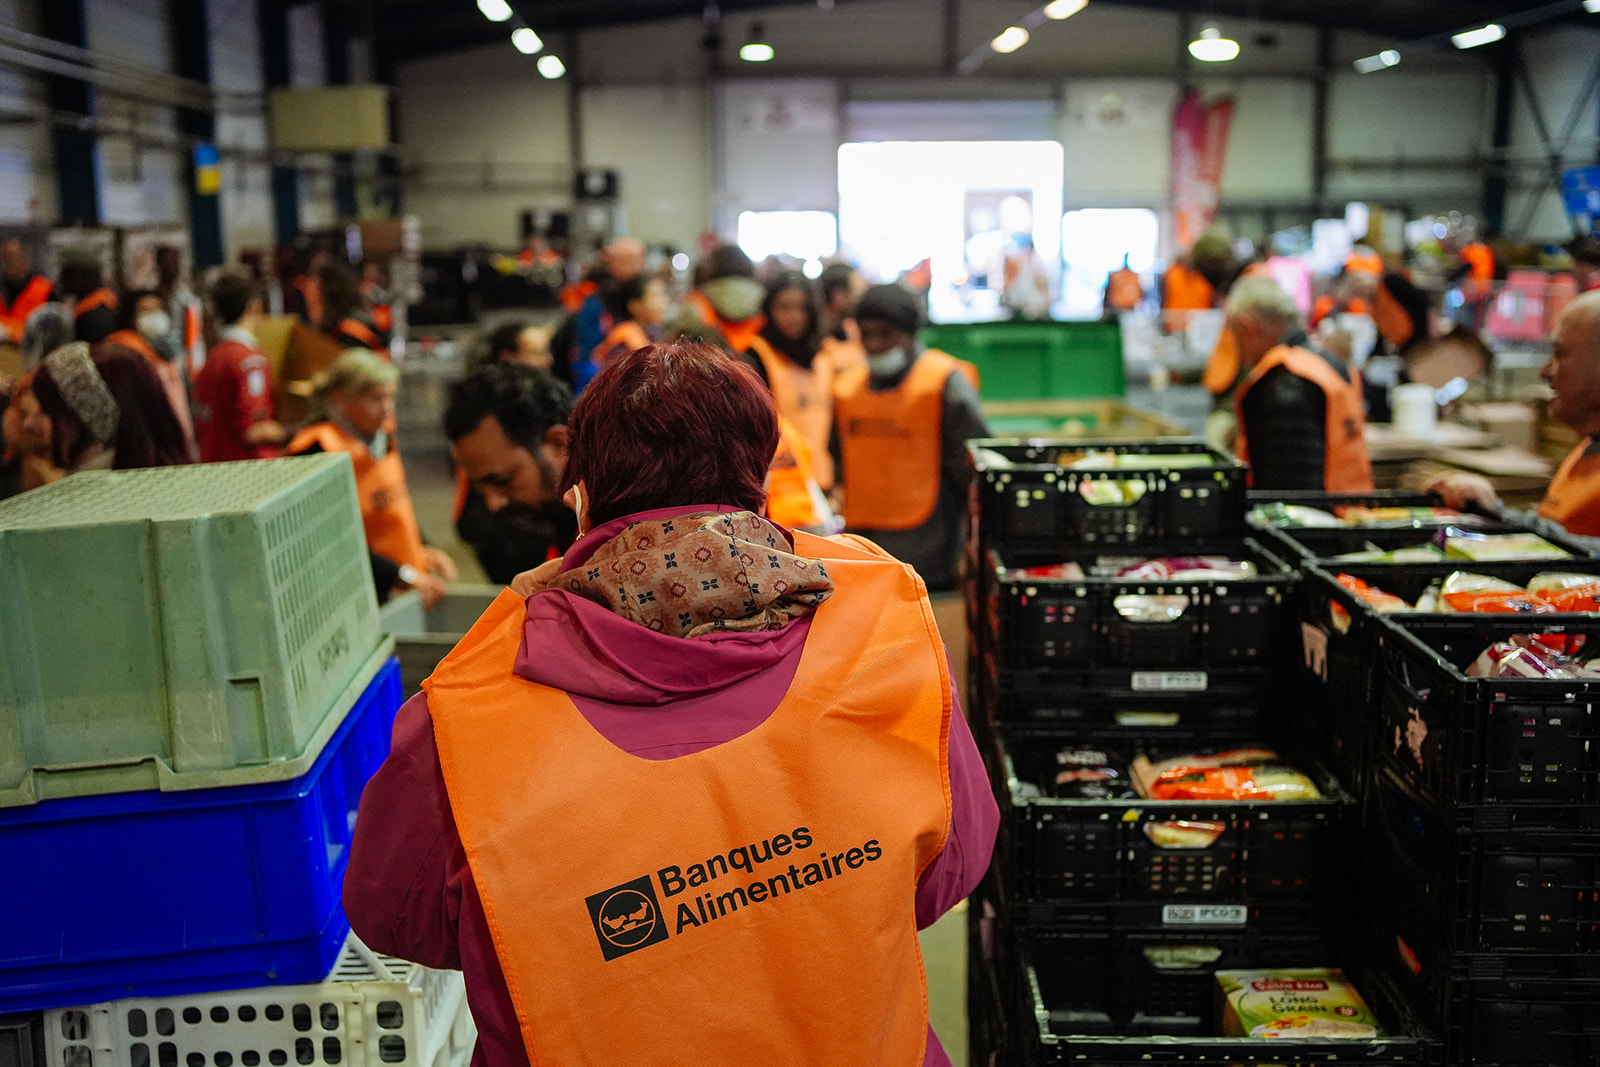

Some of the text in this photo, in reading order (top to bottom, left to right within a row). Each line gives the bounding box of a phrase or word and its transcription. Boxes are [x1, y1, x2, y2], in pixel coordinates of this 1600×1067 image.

[657, 826, 813, 898] Banques
[676, 839, 883, 935] Alimentaires
[1269, 995, 1318, 1004] LONG
[1272, 1004, 1328, 1013] GRAIN
